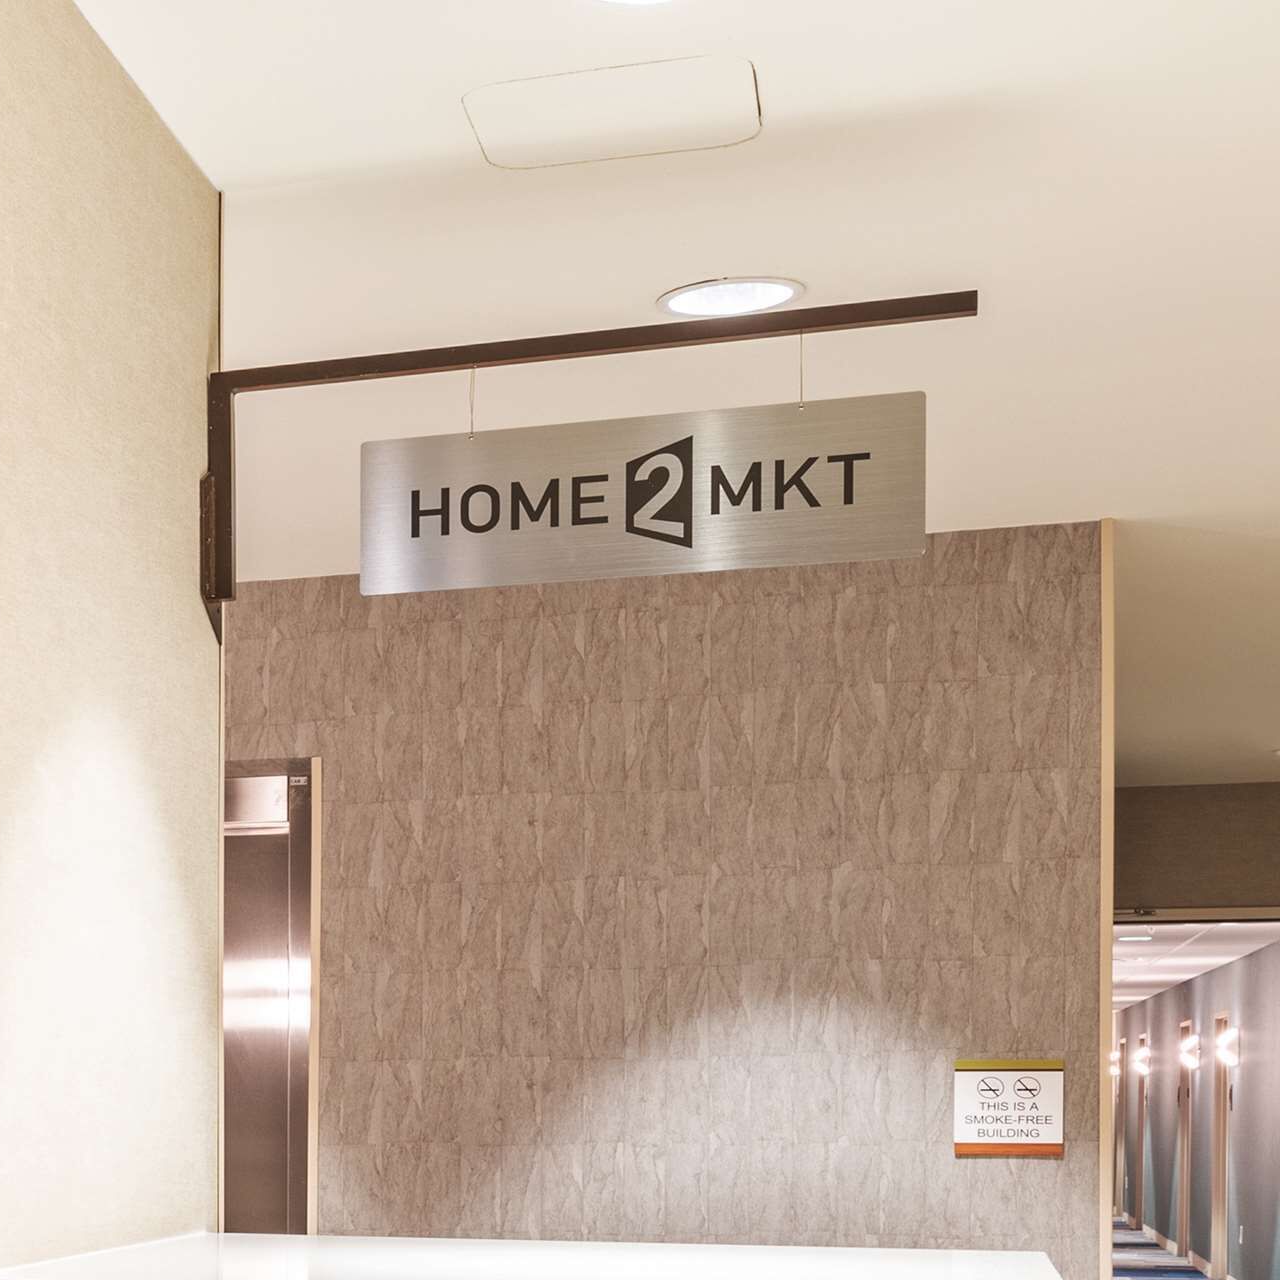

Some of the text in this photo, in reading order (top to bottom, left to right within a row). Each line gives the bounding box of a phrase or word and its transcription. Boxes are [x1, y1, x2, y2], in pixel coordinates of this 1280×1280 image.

[410, 452, 871, 538] HOME 2 MKT
[980, 1102, 1039, 1111] THIS IS A
[964, 1115, 1053, 1125] SMOKE-FREE
[977, 1129, 1040, 1138] BUILDING
